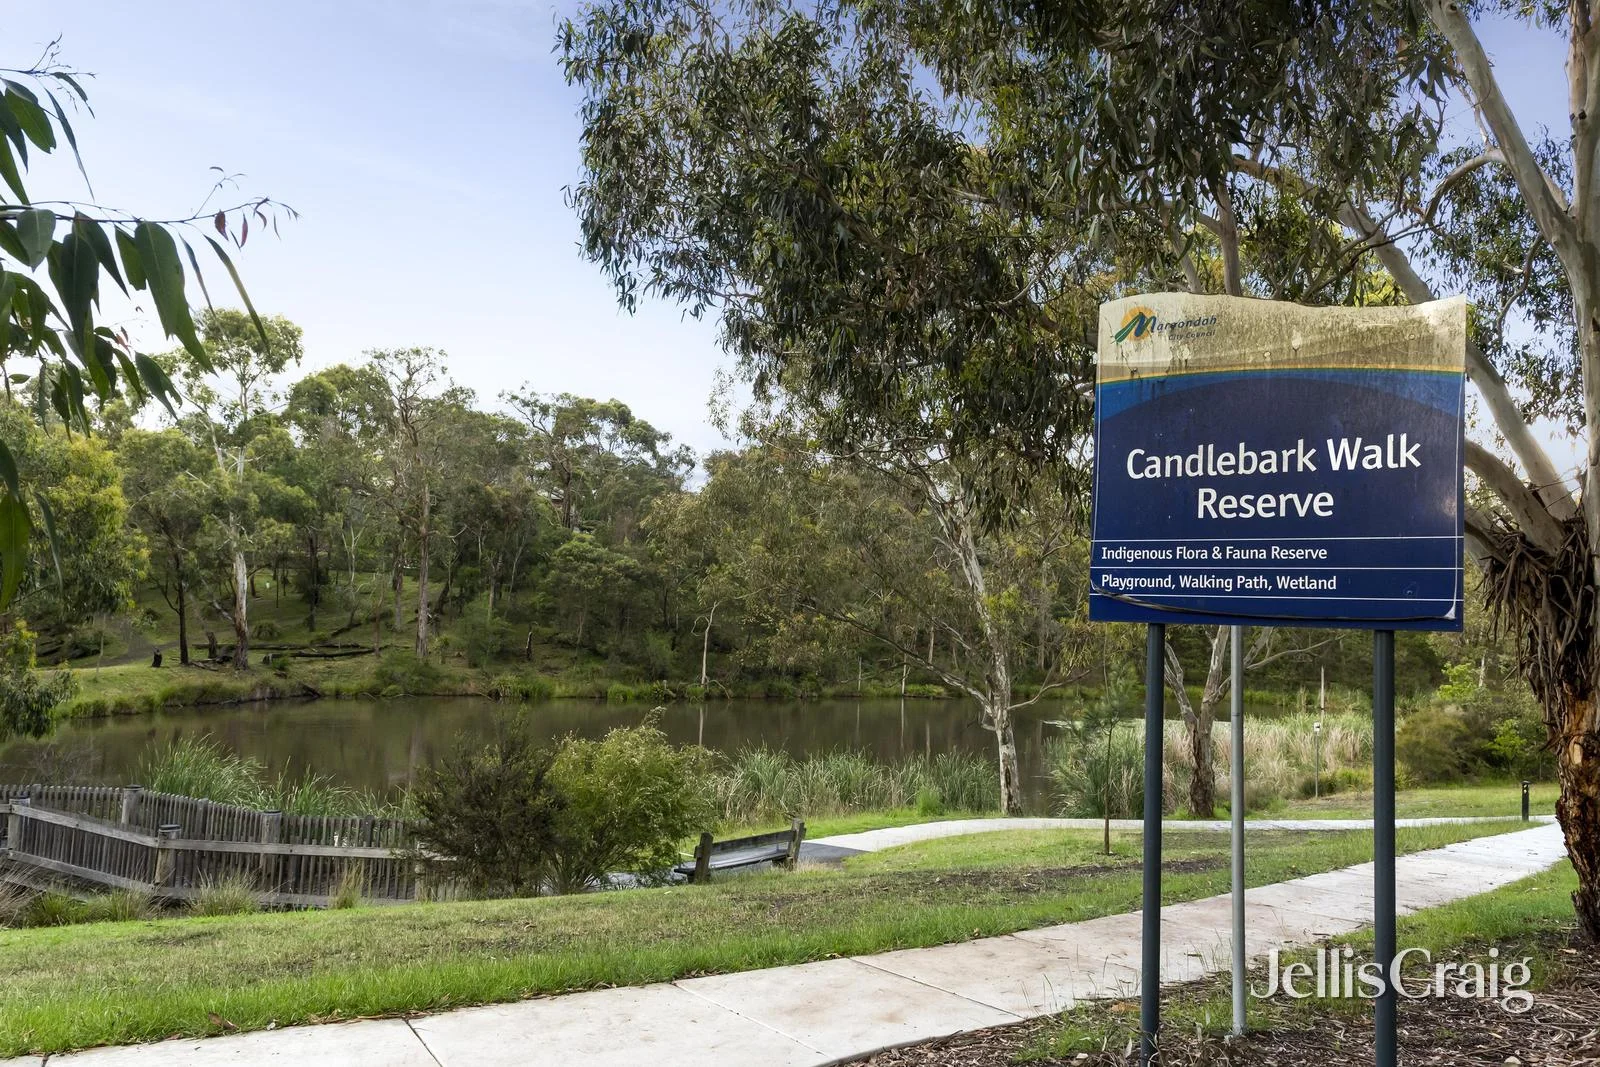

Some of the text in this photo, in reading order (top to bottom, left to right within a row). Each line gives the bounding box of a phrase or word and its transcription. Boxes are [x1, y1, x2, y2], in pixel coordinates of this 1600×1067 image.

[1126, 432, 1422, 480] Candlebark Walk
[1198, 487, 1335, 519] Reserve
[1101, 546, 1328, 562] Indigenous Flora & Fauna Reserve
[1101, 574, 1337, 592] Playground, Walking Path, Wetland
